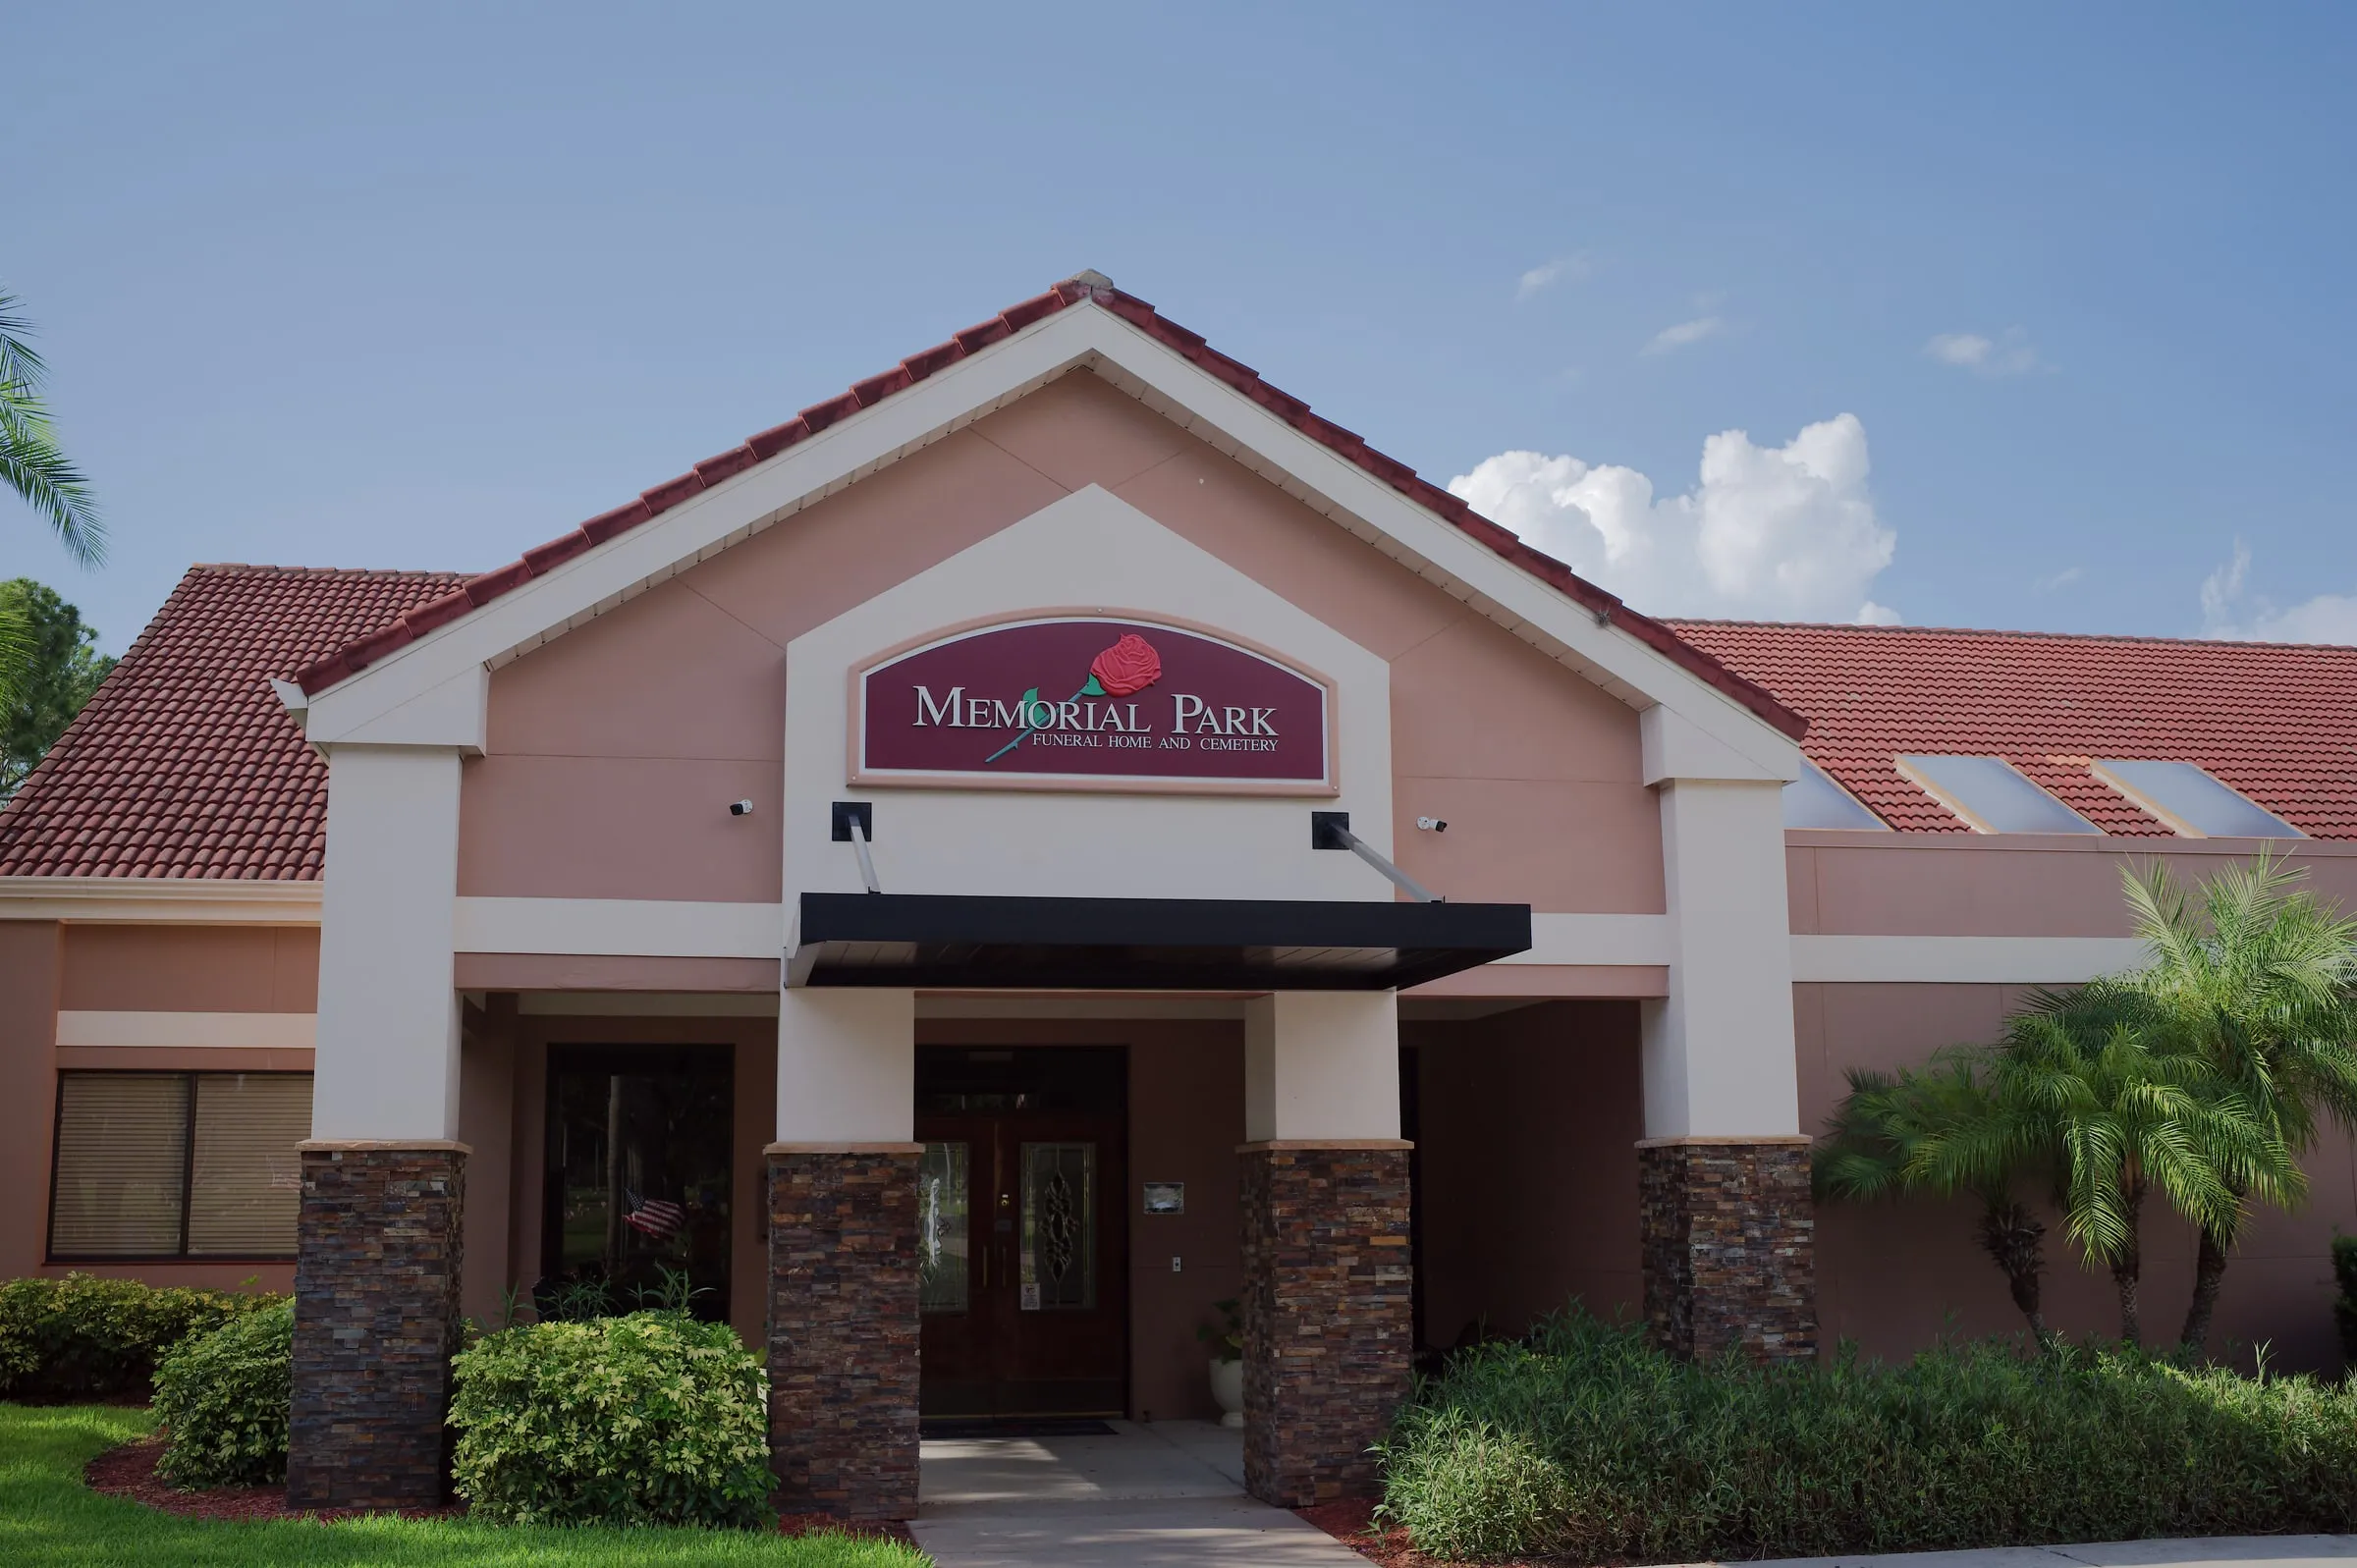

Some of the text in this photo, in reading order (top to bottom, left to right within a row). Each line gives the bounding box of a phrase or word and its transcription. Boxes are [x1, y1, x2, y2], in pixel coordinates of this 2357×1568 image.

[912, 685, 1280, 736] MEMORIAL PARK
[1032, 733, 1280, 752] FUNERAL HOME AND CEMETERY
